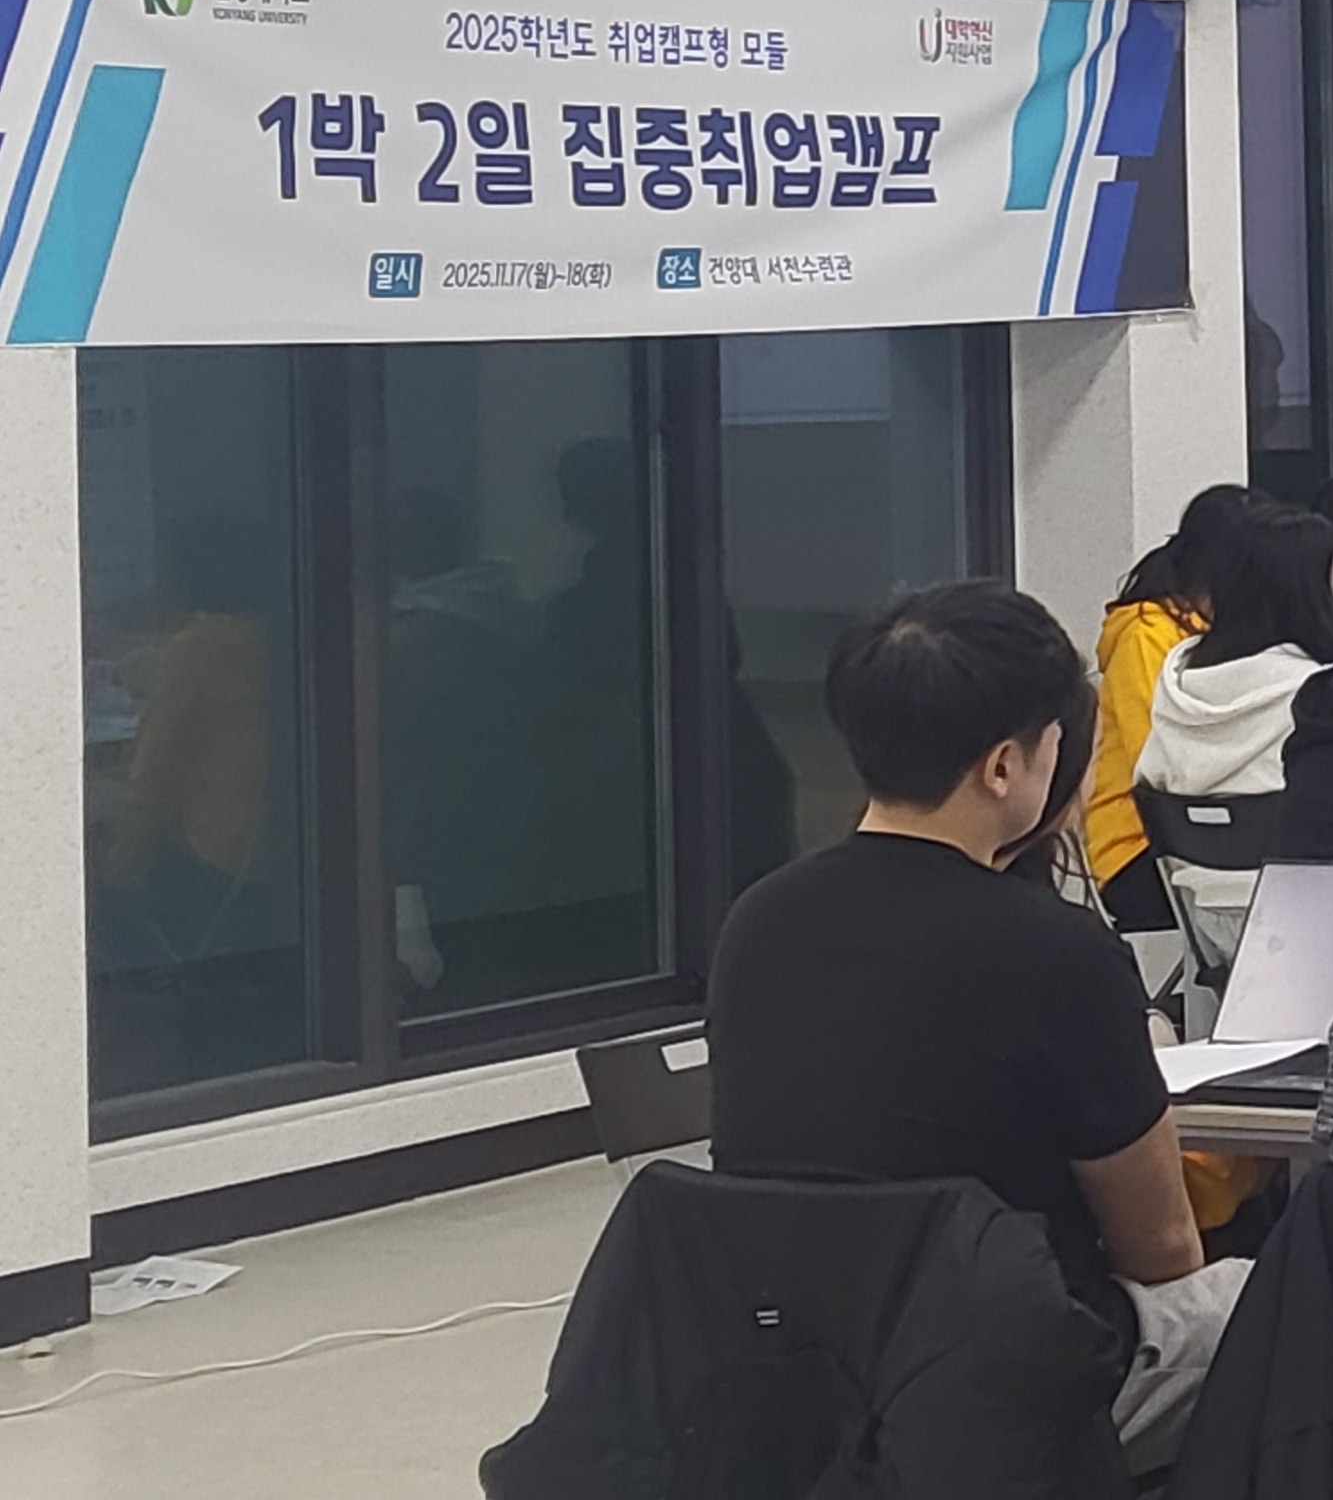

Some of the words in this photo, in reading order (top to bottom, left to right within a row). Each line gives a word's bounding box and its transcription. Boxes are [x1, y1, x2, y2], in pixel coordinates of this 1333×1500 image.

[445, 11, 598, 60] 2025학년도
[608, 20, 729, 69] 취업캠프형
[257, 92, 386, 203] 1박
[415, 100, 534, 206] 2일
[561, 104, 941, 211] 집중취업캠프
[374, 256, 417, 292] 일시
[661, 254, 697, 284] 장소
[707, 255, 761, 285] 건양대
[767, 254, 853, 283] 서천수련관
